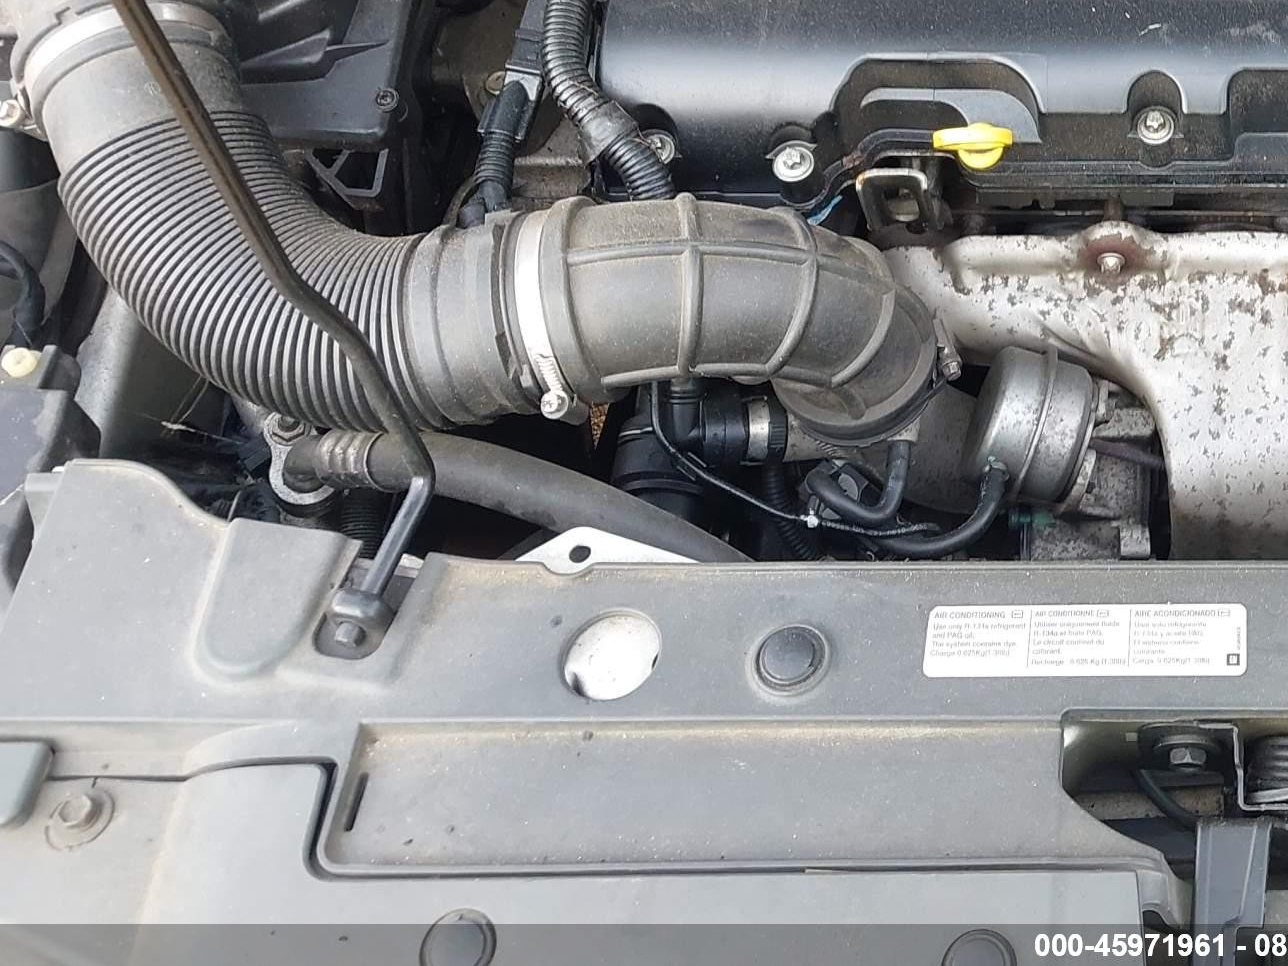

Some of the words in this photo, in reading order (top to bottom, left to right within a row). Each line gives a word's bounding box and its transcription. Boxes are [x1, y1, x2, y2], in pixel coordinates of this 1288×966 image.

[934, 611, 947, 619] AIR
[949, 611, 1006, 619] CONDITIONING
[1134, 609, 1151, 617] AIRE
[1153, 609, 1215, 617] ACONDICIONADO
